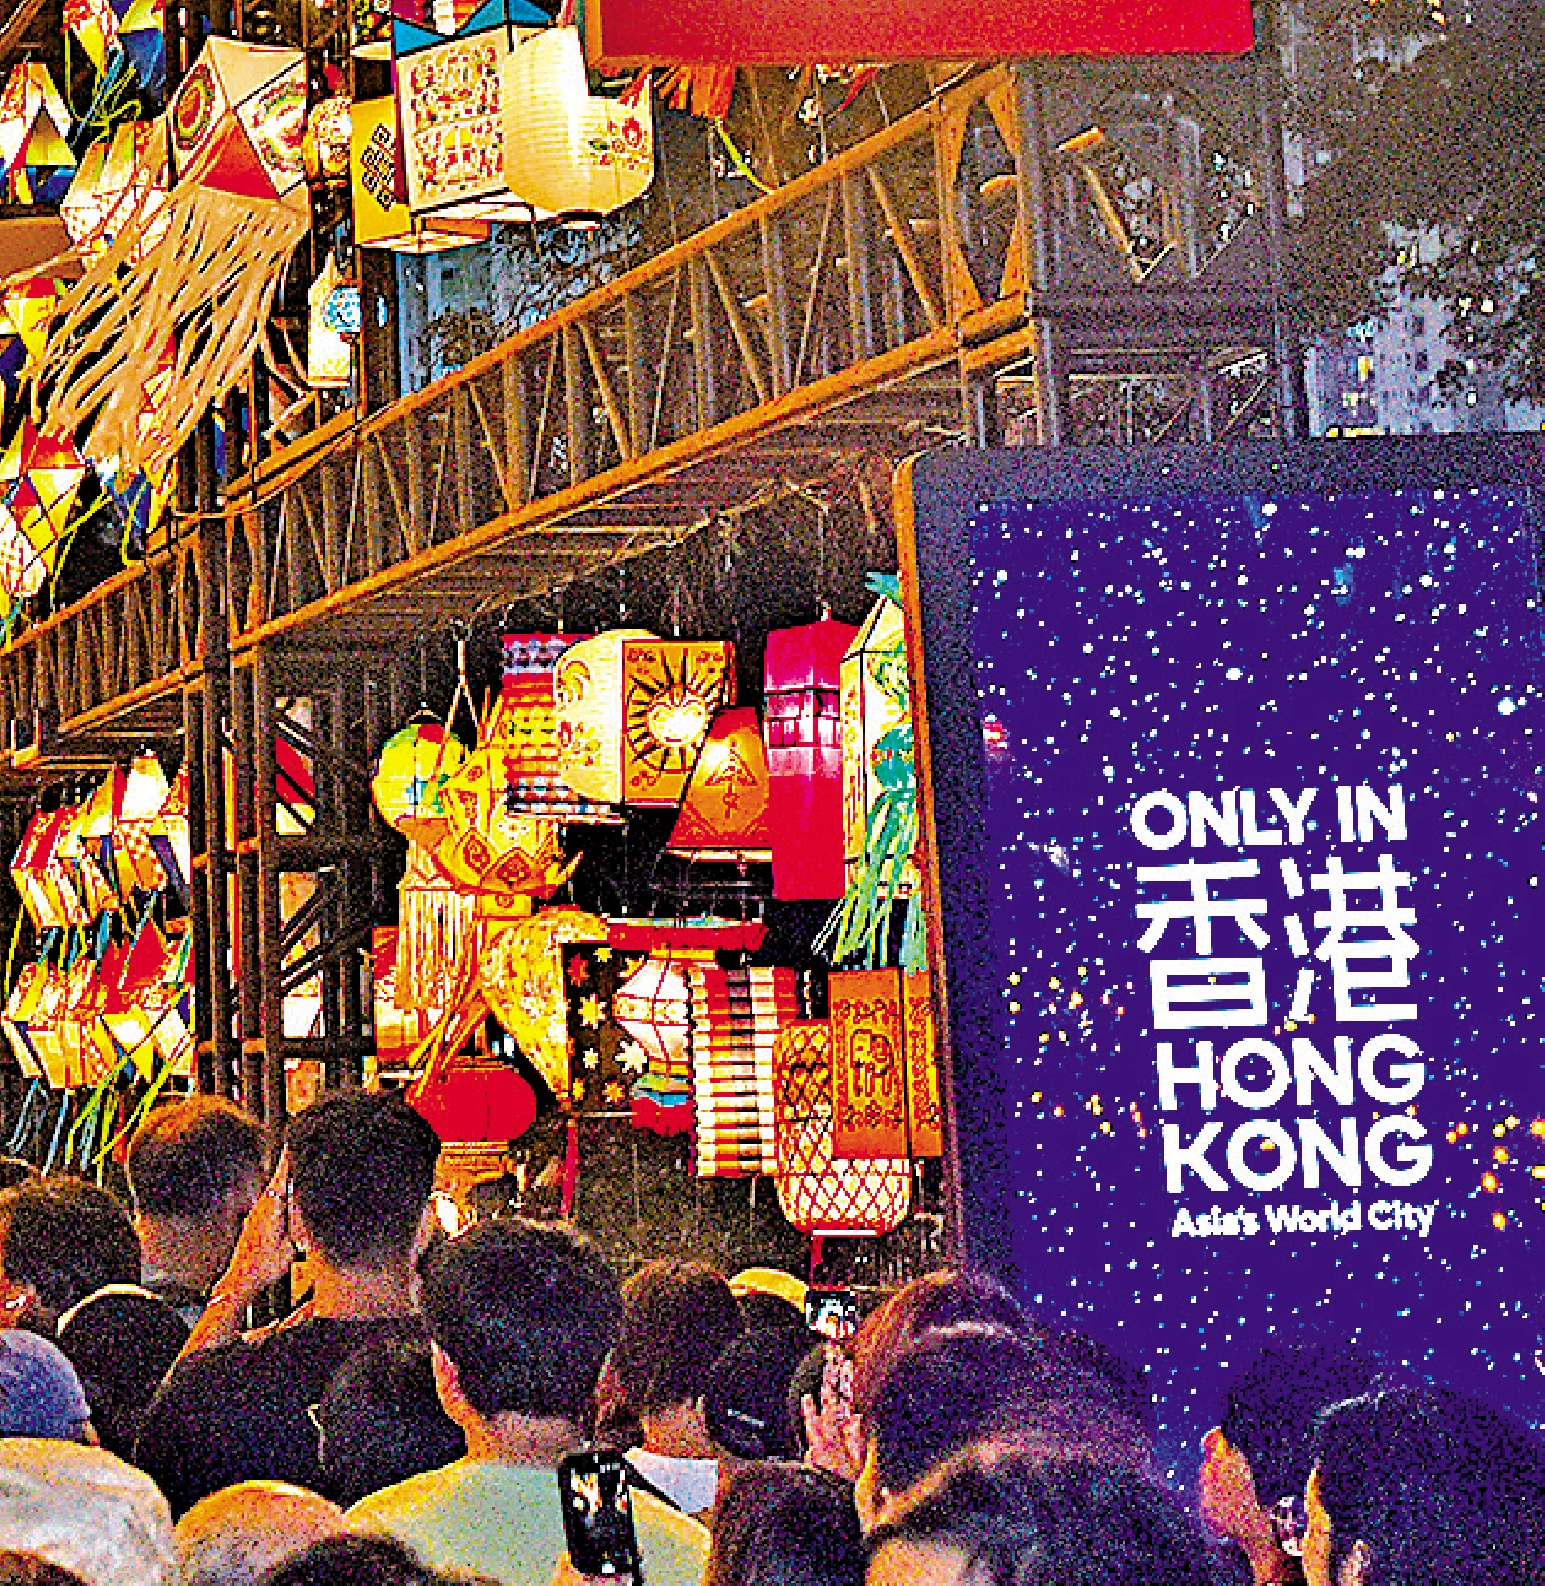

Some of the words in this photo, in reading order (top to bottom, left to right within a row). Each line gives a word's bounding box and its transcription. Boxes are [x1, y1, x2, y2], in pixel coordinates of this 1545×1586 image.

[1128, 784, 1318, 852] ONLY
[1334, 779, 1409, 844] IN
[1133, 852, 1421, 1031] 香港
[1155, 1032, 1426, 1112] HONG
[1159, 1112, 1434, 1195] KONG
[1170, 1203, 1262, 1239] Asia's
[1263, 1198, 1363, 1235] World
[1366, 1198, 1436, 1239] City
